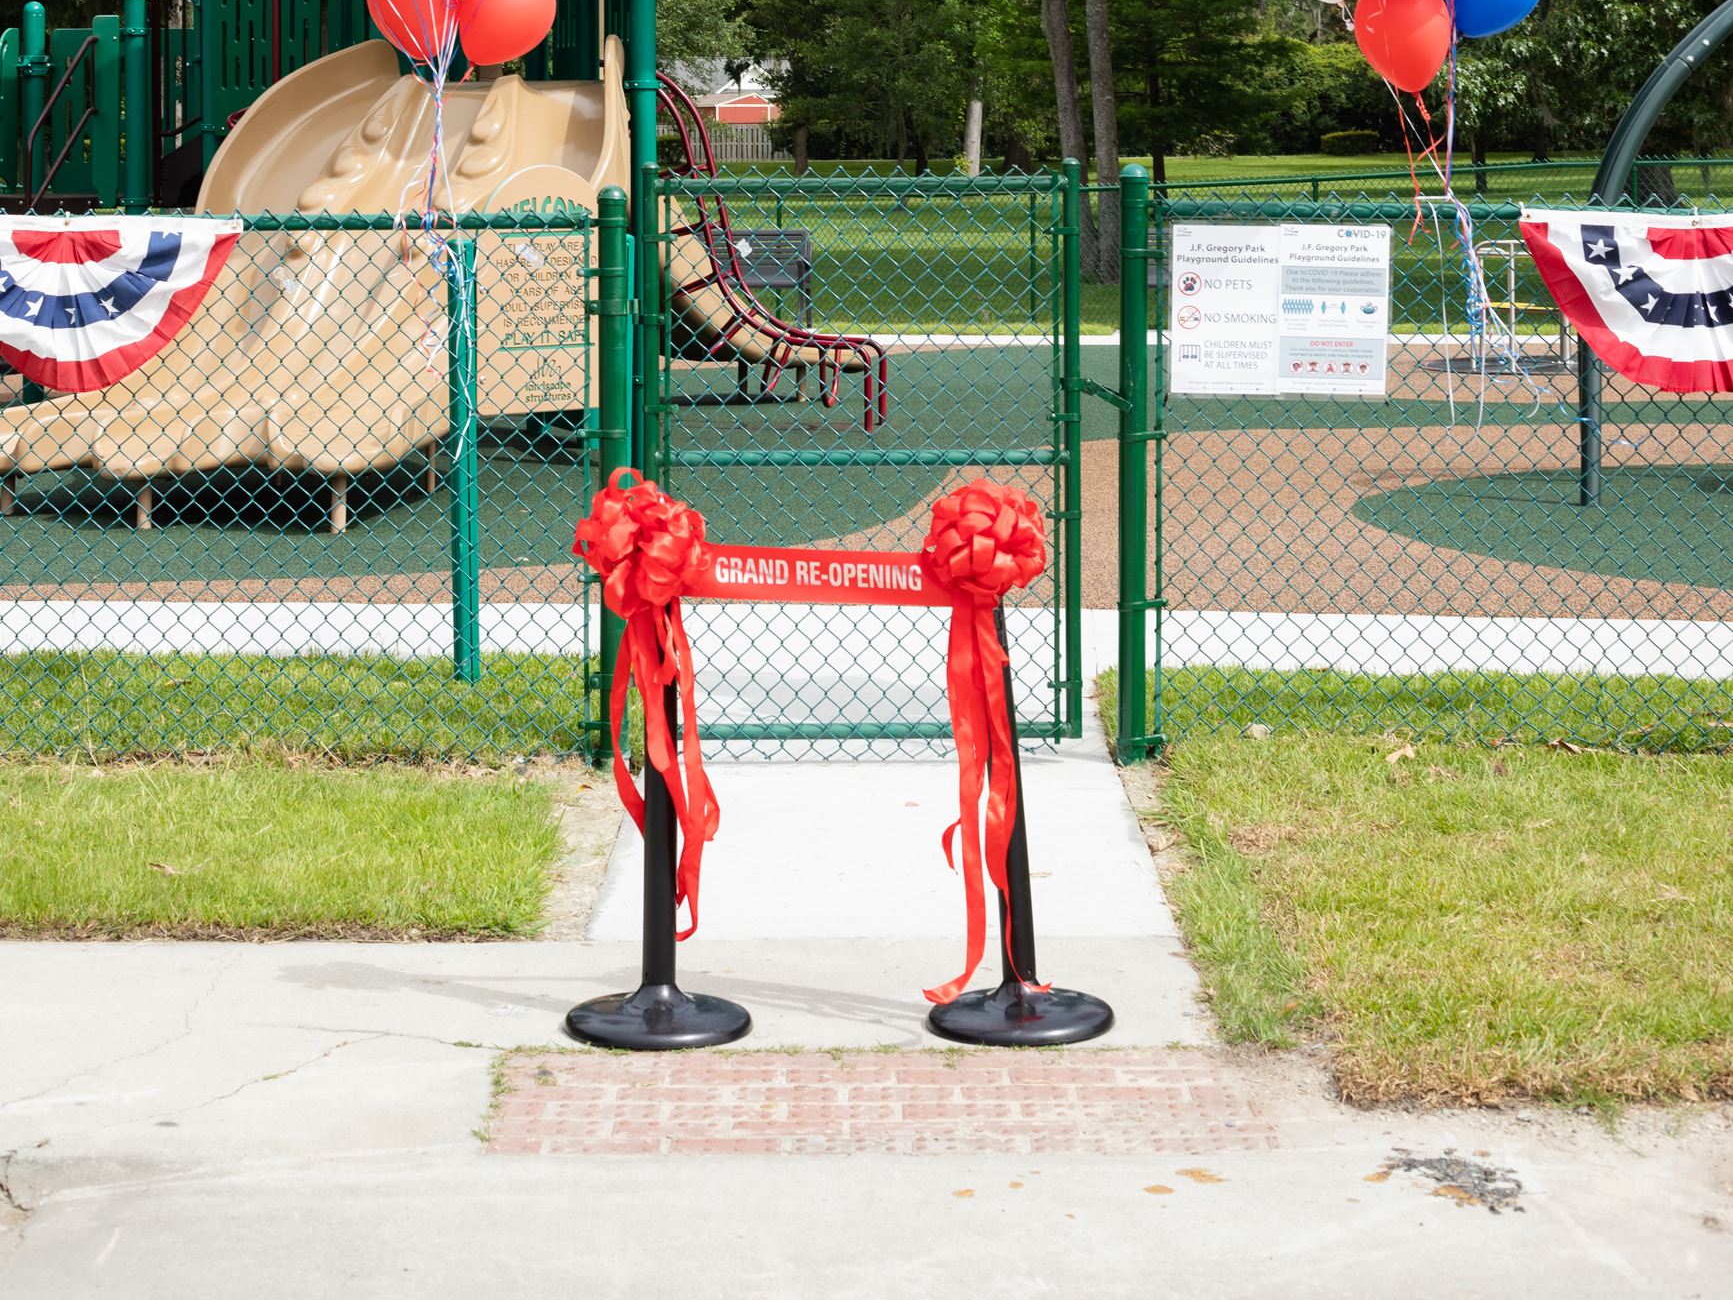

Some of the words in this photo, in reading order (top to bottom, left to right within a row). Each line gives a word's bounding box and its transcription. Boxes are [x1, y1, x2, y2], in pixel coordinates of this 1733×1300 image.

[1206, 244, 1243, 254] Gregory
[1315, 244, 1348, 252] Gregory
[550, 255, 597, 266] DESIND
[1177, 254, 1229, 264] Playground
[1231, 256, 1279, 264] Guidelines
[1289, 253, 1335, 262] Playground
[1337, 255, 1380, 263] Guidelines
[524, 271, 571, 283] CHILDRN
[1204, 279, 1222, 289] NO
[1225, 279, 1253, 290] PETS
[501, 302, 527, 313] DULT
[503, 319, 512, 327] IS
[1204, 313, 1221, 323] NO
[1224, 313, 1277, 324] SMOKING
[505, 332, 535, 345] PLAY
[541, 331, 551, 344] IT
[1204, 340, 1247, 349] CHILDREN
[1249, 341, 1272, 349] MUST
[1204, 351, 1215, 359] BE
[1216, 351, 1268, 360] SUPERVISED
[1204, 361, 1214, 369] AT
[1216, 361, 1231, 369] ALL
[1233, 361, 1258, 370] TIMES
[715, 556, 789, 585] GRAND
[795, 560, 922, 592] RE-OPENING
